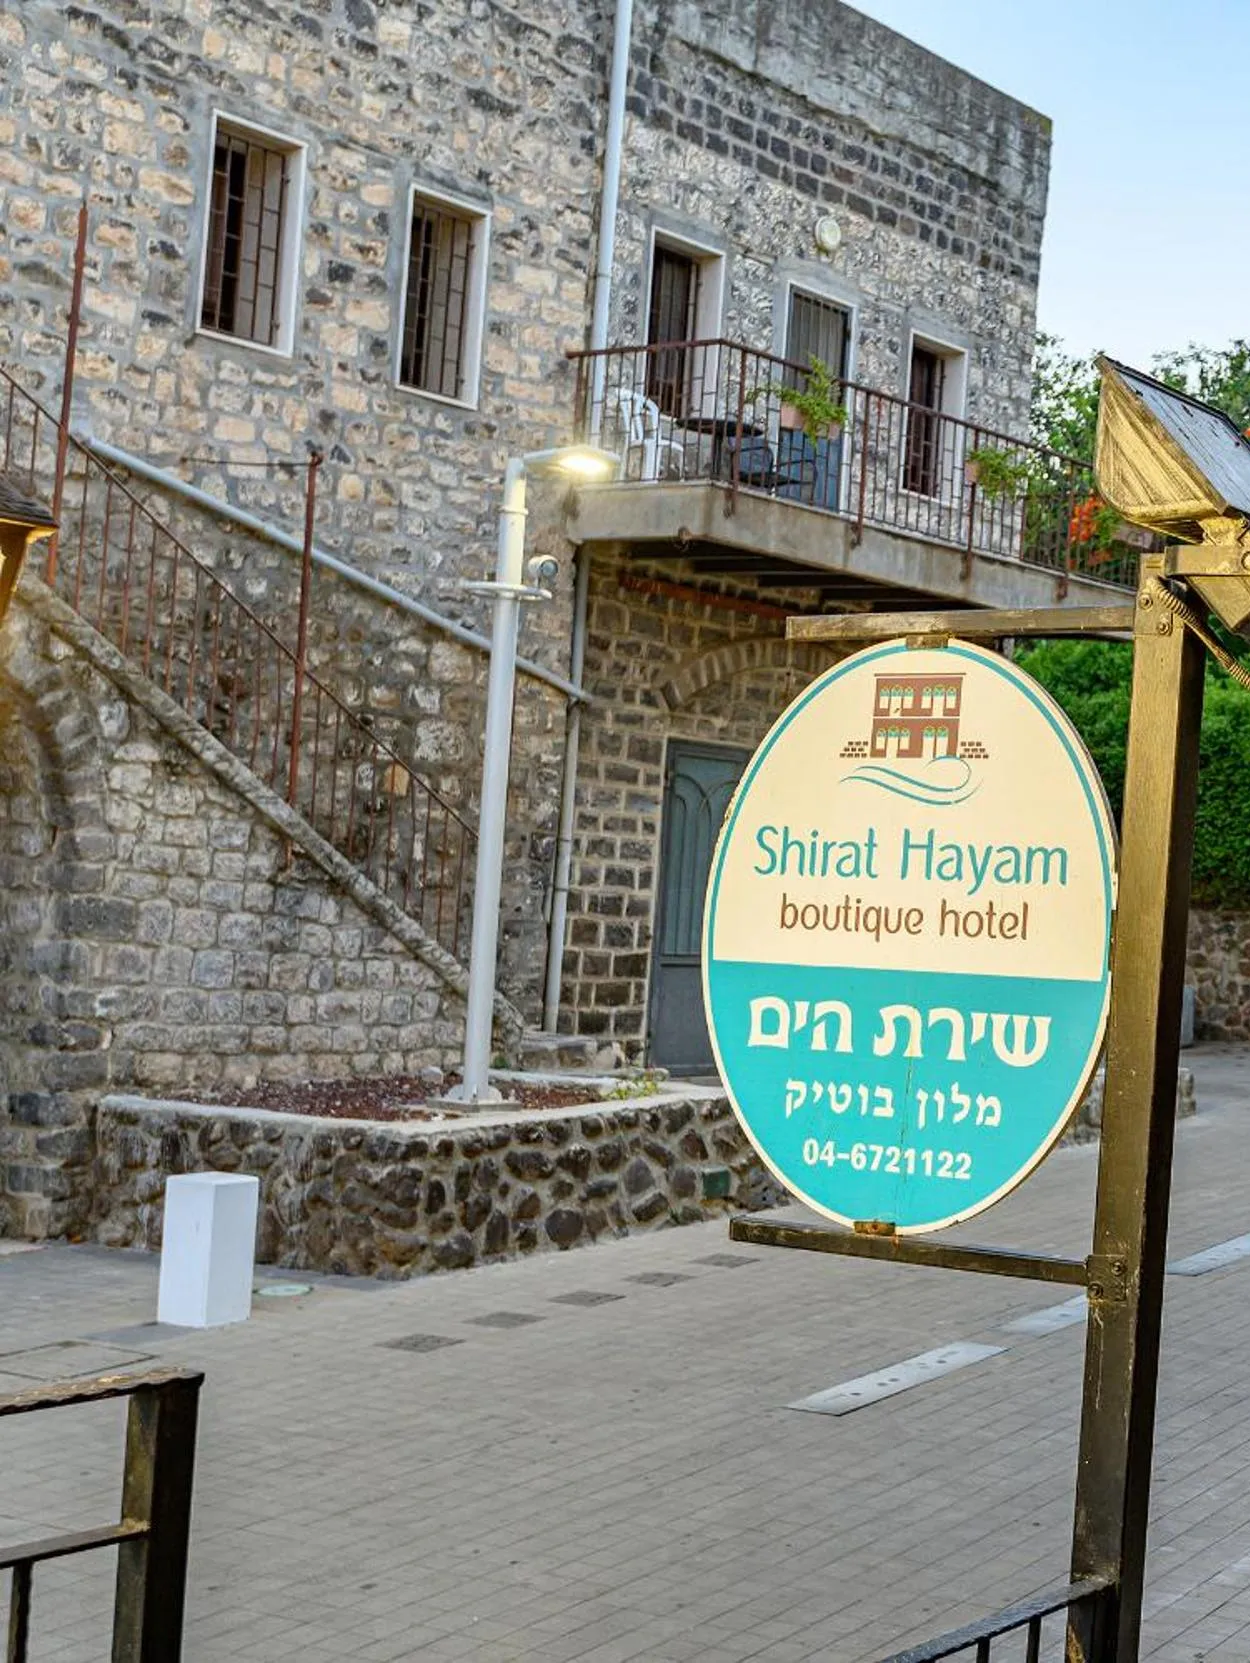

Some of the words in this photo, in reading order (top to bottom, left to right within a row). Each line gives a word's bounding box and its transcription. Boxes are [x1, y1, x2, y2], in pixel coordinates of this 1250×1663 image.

[753, 825, 878, 880] Shirat
[900, 828, 1068, 896] Hayam
[779, 892, 924, 943] boutique
[939, 898, 1029, 941] hotel
[747, 996, 853, 1053] הים
[872, 1002, 1052, 1068] שירת
[785, 1079, 895, 1118] בוטיק
[916, 1082, 1002, 1129] מלון
[802, 1138, 972, 1180] 04-6721122
